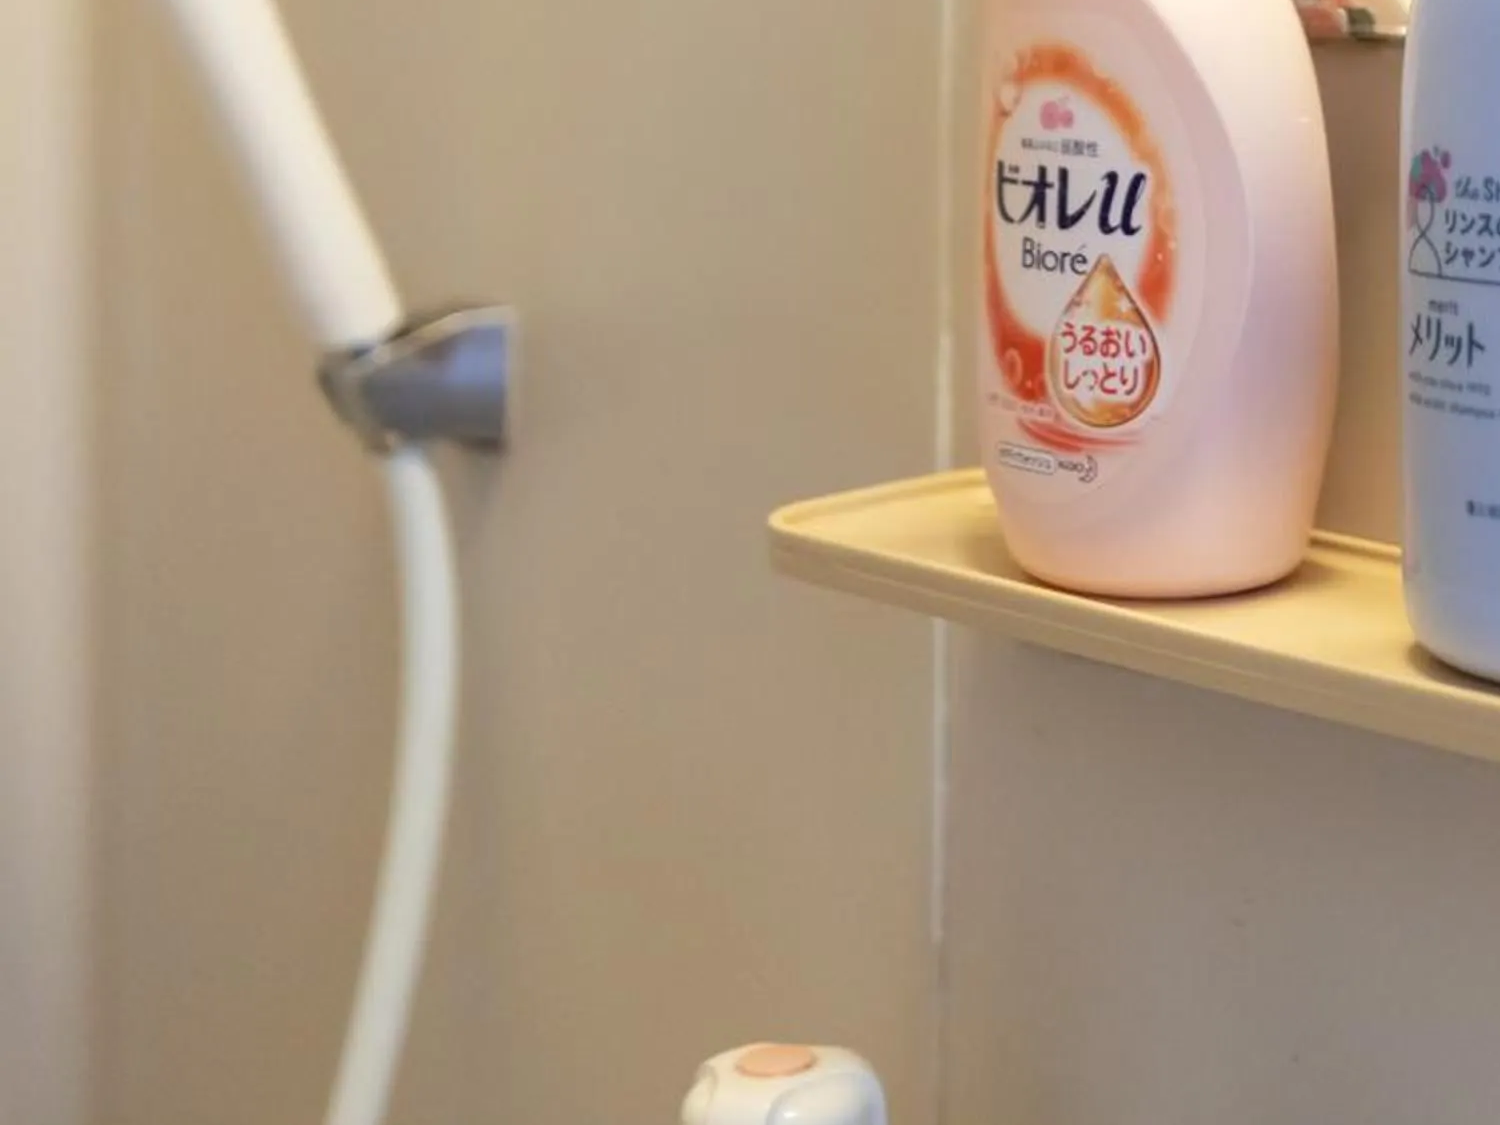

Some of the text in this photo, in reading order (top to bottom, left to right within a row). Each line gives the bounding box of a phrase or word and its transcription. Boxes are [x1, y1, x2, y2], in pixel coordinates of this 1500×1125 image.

[1022, 236, 1089, 276] Bioré
[1061, 322, 1147, 359] うるおい
[1408, 311, 1487, 369] メリット
[1063, 360, 1138, 396] しっとり
